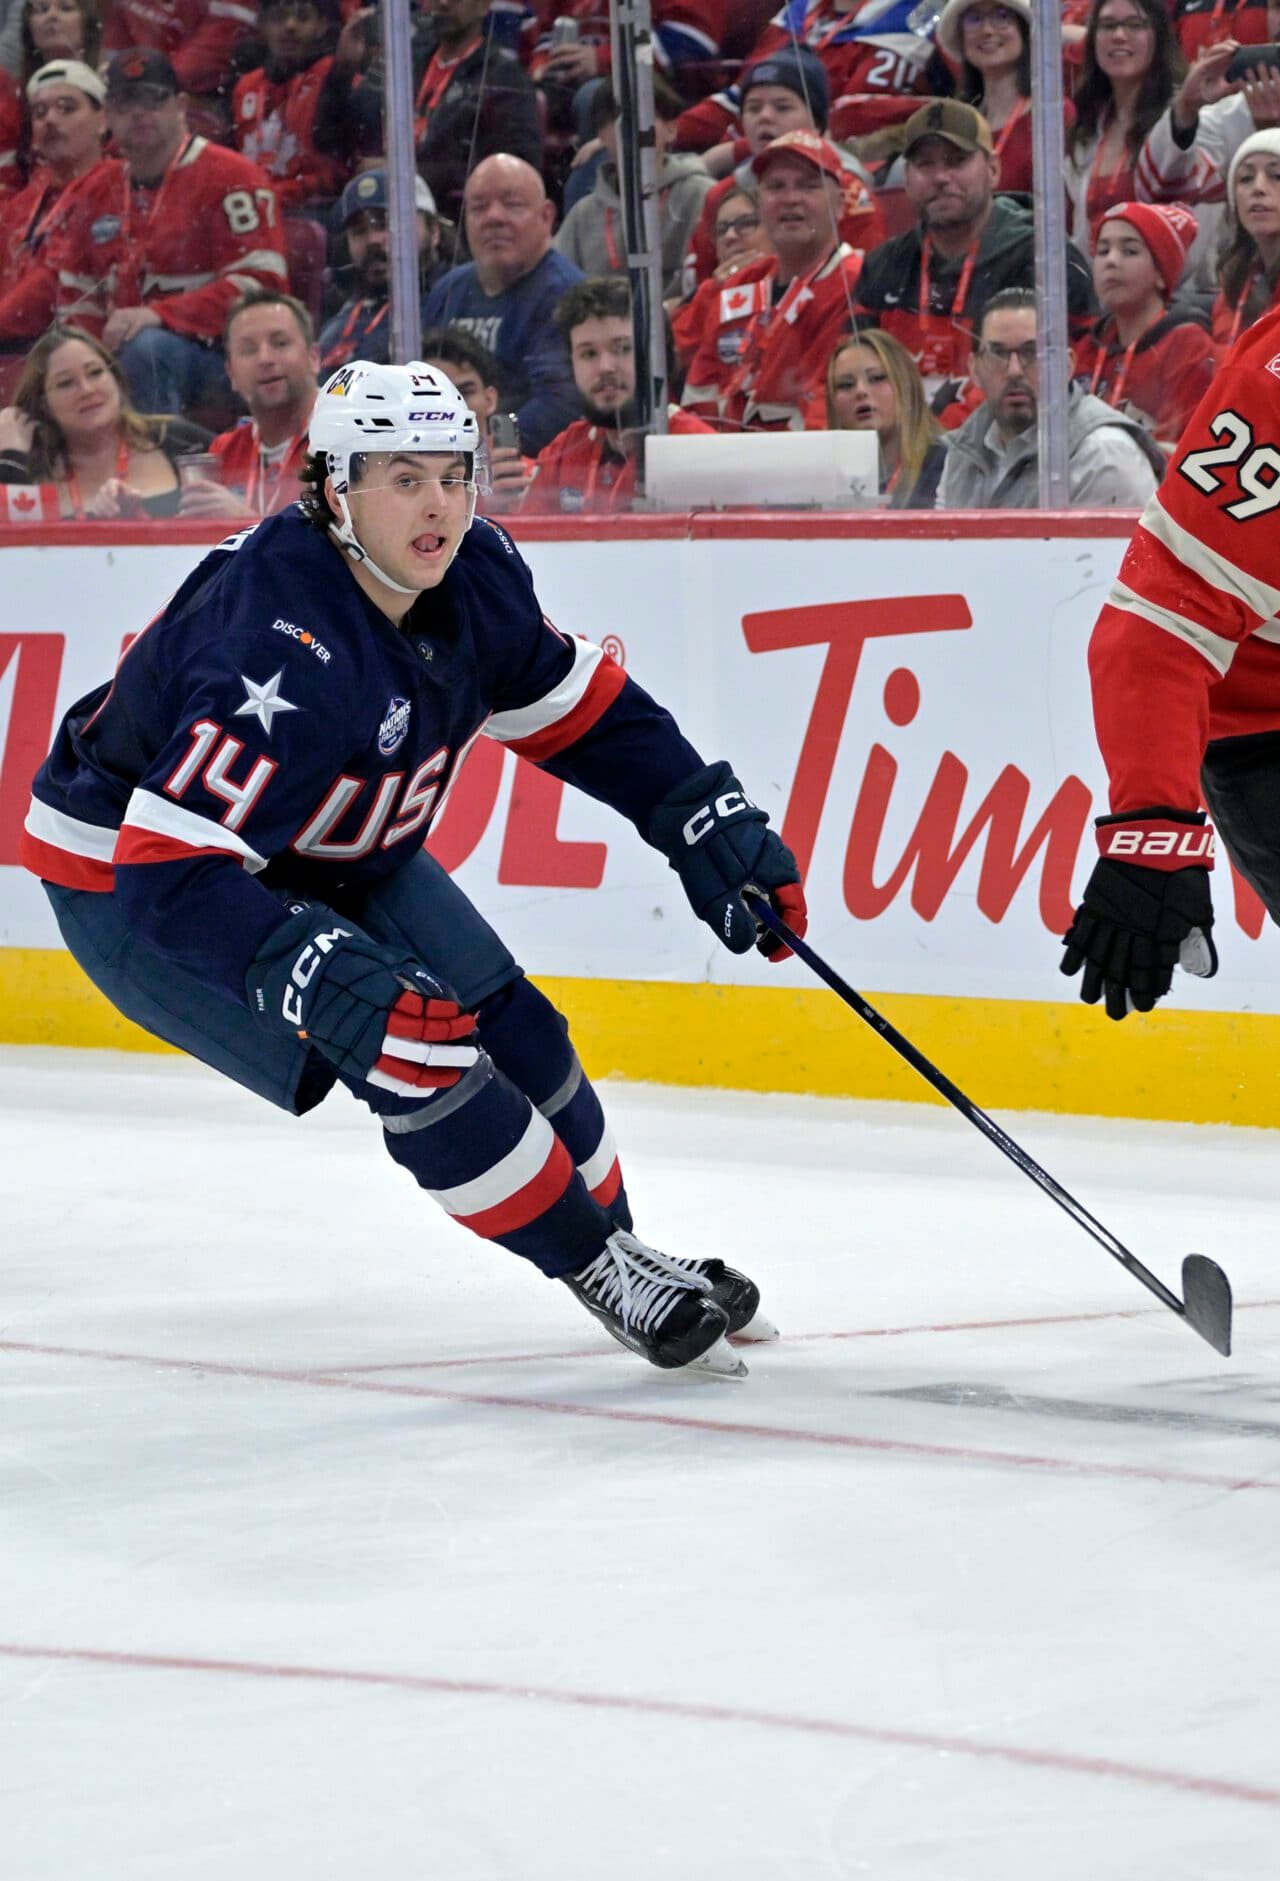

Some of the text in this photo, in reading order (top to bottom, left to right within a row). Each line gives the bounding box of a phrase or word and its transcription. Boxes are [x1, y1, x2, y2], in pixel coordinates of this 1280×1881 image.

[223, 188, 277, 235] 87
[407, 411, 456, 421] CCM
[271, 618, 332, 664] DISCOVER
[379, 700, 411, 736] NATIONS
[162, 718, 279, 832] 14
[741, 592, 1095, 936] Tim
[289, 715, 488, 861] US
[1107, 830, 1215, 858] BAU
[725, 903, 734, 938] CCM
[282, 927, 353, 1026] CCM
[256, 988, 265, 1012] FABER
